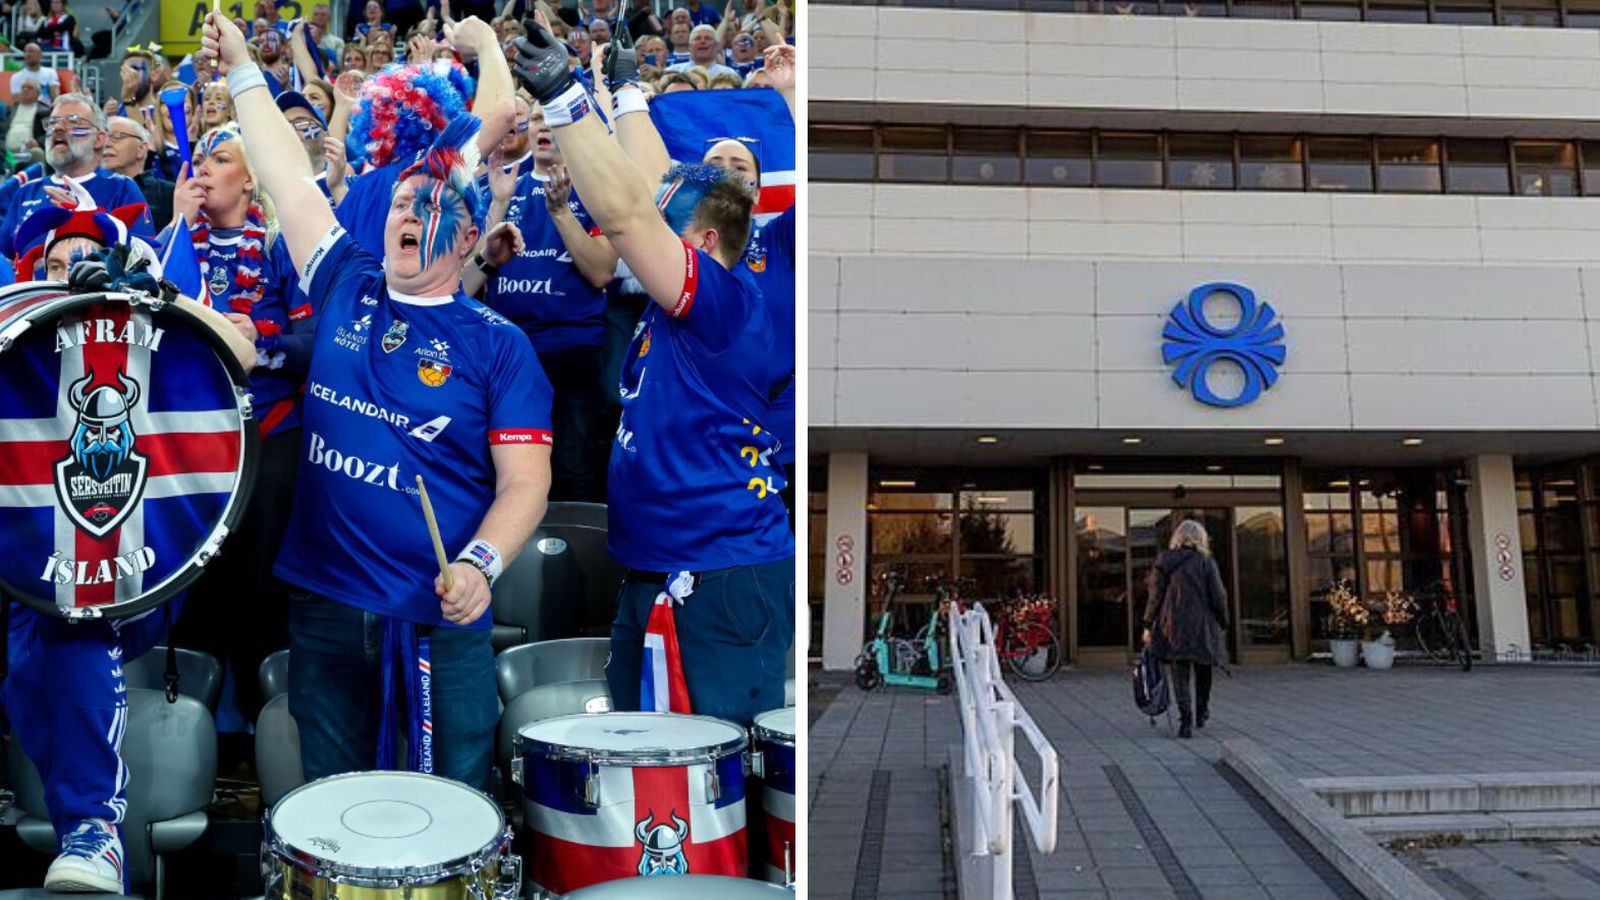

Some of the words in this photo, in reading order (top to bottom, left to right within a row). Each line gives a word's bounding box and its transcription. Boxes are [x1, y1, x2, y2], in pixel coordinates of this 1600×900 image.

[310, 381, 410, 430] ICELANDAIR
[499, 433, 532, 443] Kempa
[70, 471, 133, 497] SÉRSVEITIN
[39, 546, 156, 585] ÍSLAND
[422, 735, 433, 774] CELAND
